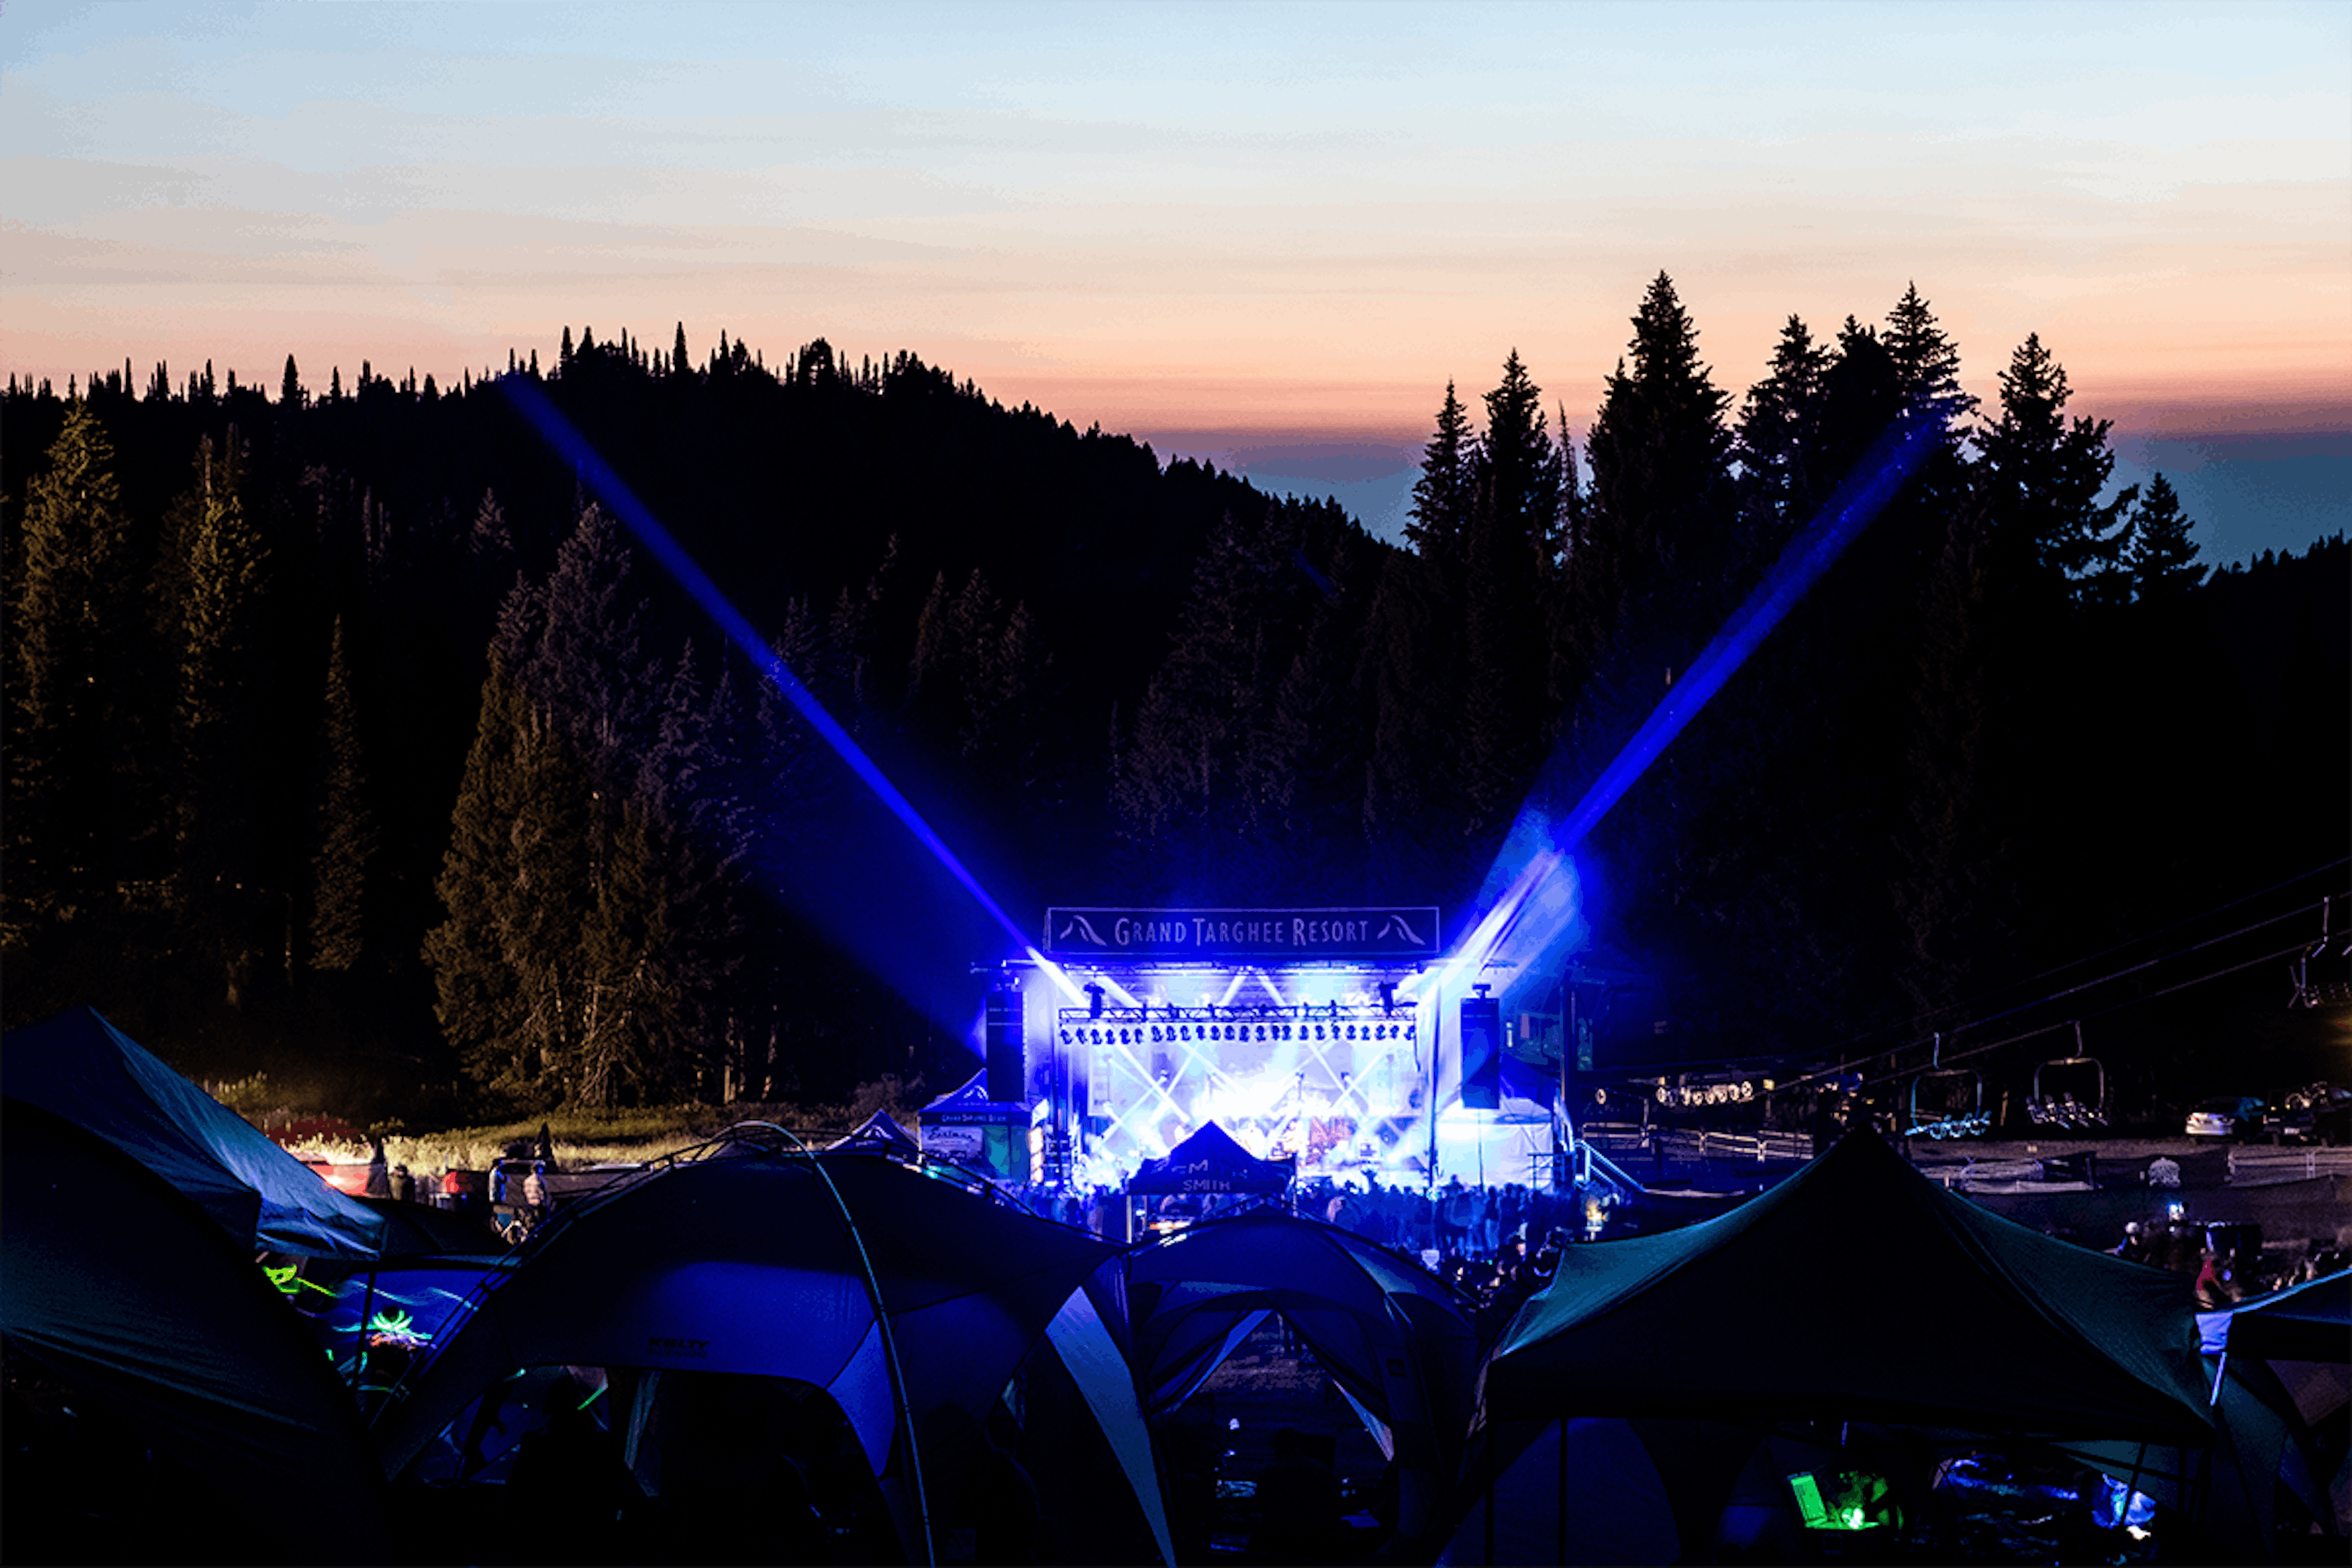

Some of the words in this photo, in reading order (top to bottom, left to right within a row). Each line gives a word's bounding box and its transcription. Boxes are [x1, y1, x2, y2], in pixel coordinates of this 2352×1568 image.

[1114, 917, 1187, 946] GRAND
[1191, 918, 1284, 947] TARGHEE
[1292, 918, 1369, 946] RESORT
[1183, 1179, 1231, 1191] SMITH
